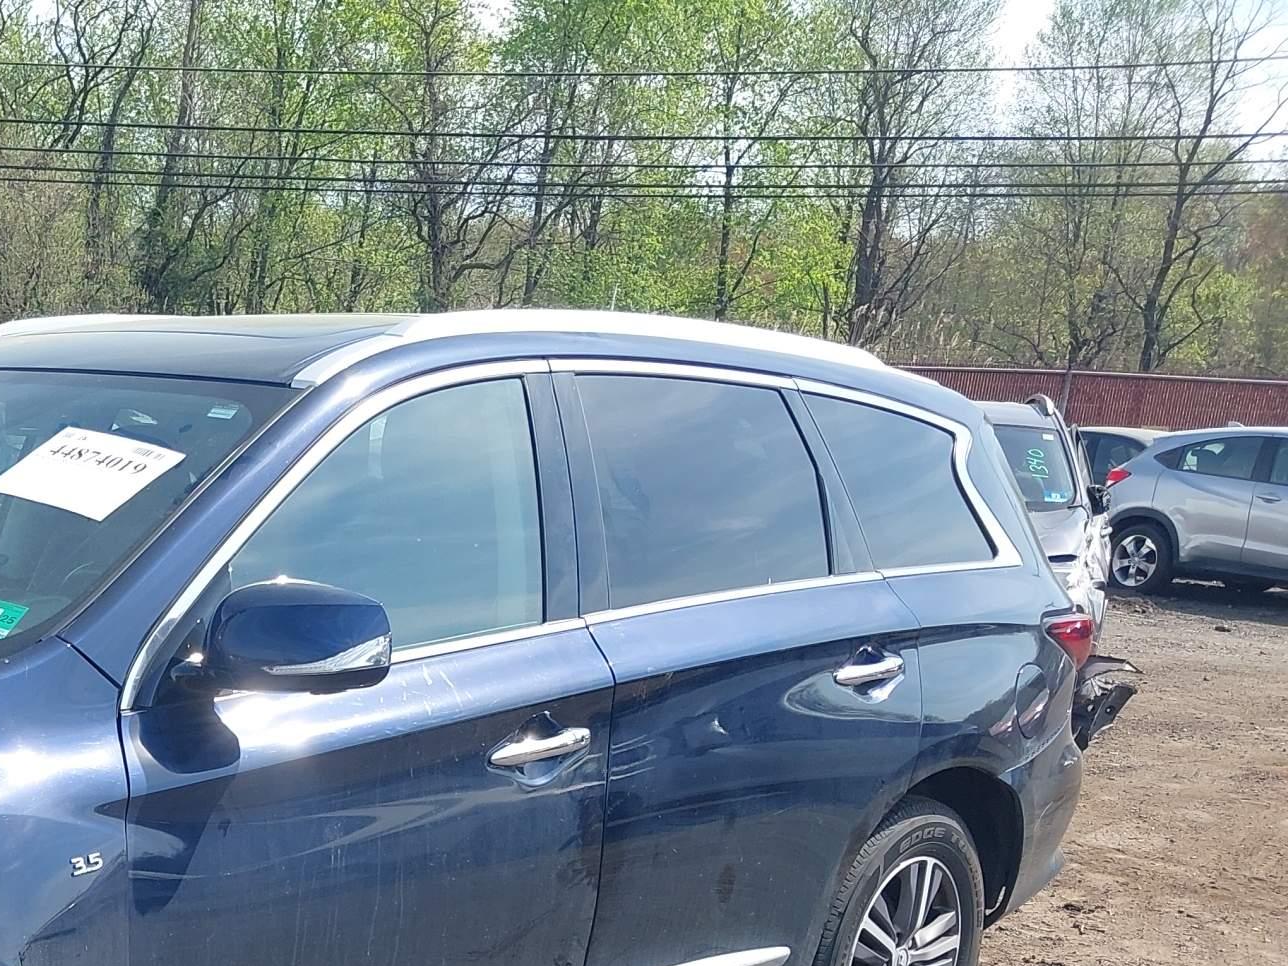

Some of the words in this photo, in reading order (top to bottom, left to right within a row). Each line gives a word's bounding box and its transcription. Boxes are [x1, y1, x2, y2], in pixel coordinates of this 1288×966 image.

[49, 444, 148, 475] 44874019
[1026, 448, 1049, 478] 1340
[0, 614, 17, 625] 25
